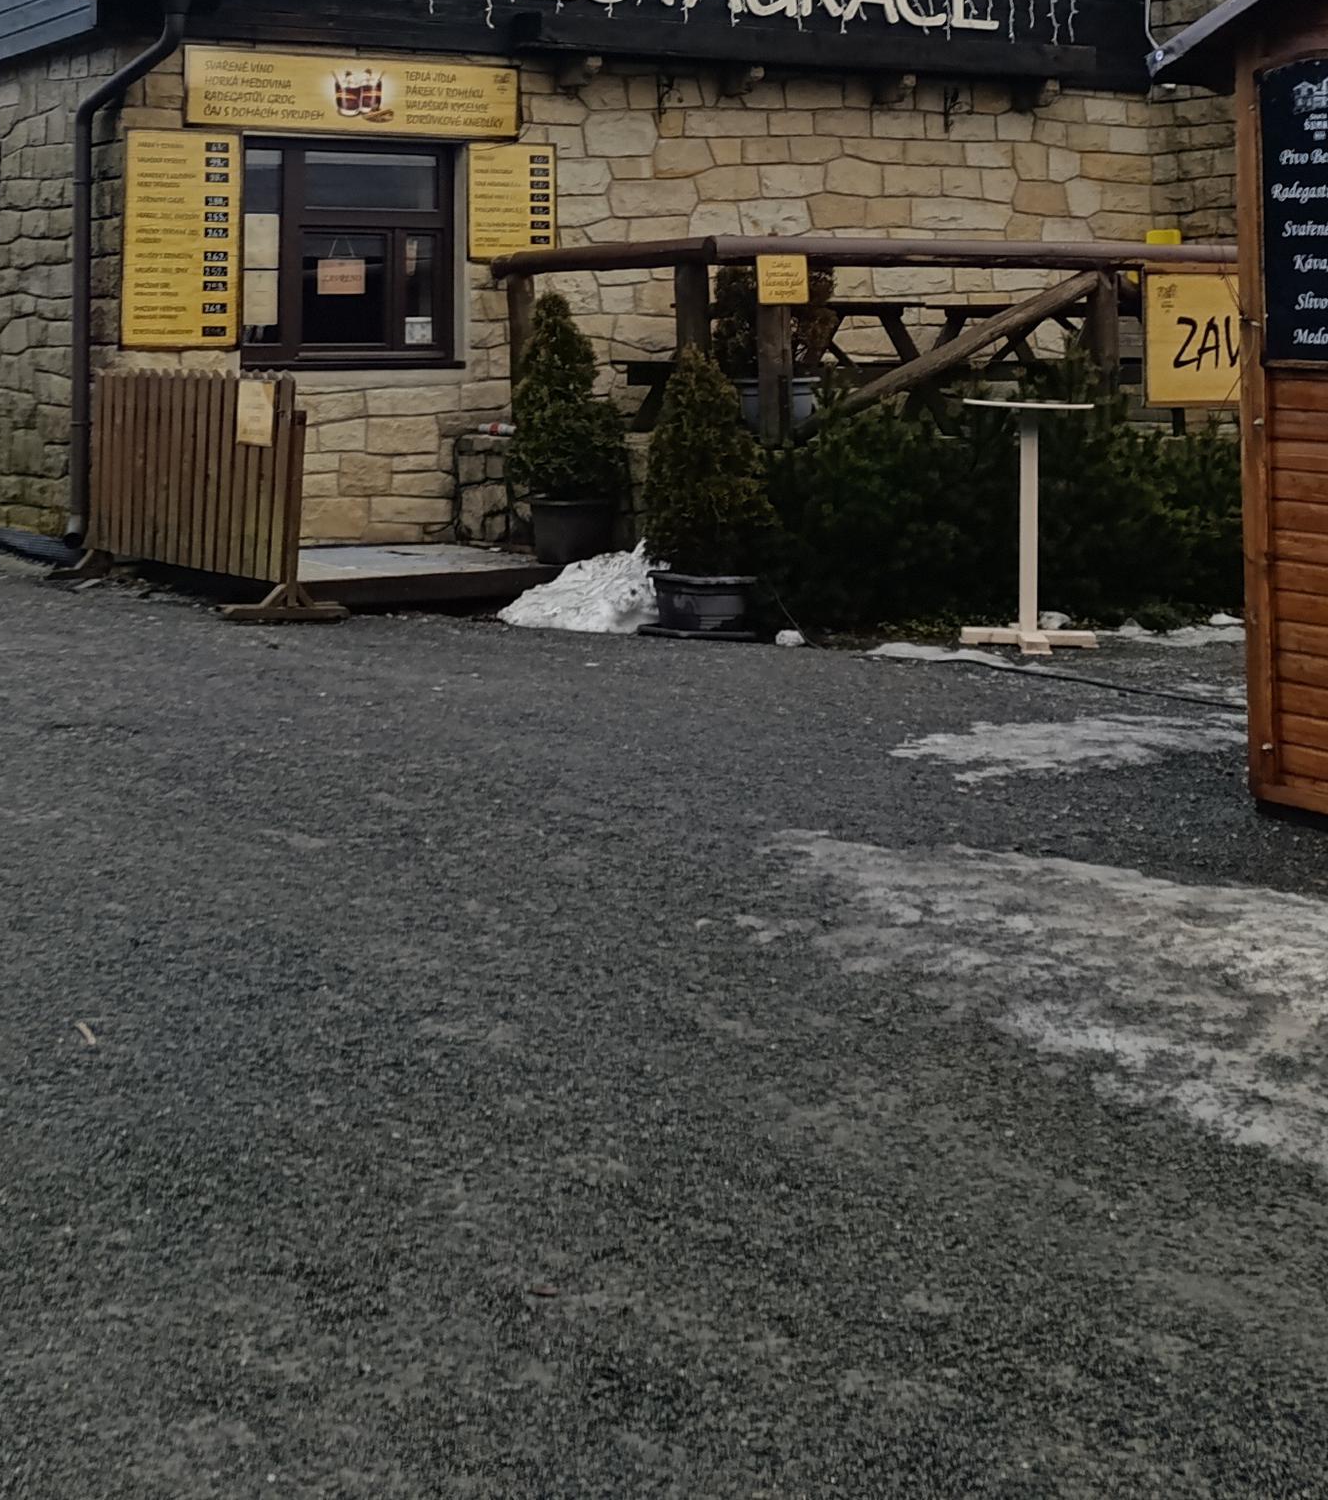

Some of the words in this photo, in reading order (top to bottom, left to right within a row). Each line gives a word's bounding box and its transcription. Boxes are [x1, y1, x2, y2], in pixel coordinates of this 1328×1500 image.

[203, 103, 222, 116] ČAJ
[224, 106, 230, 116] S
[1279, 148, 1309, 165] Pivo
